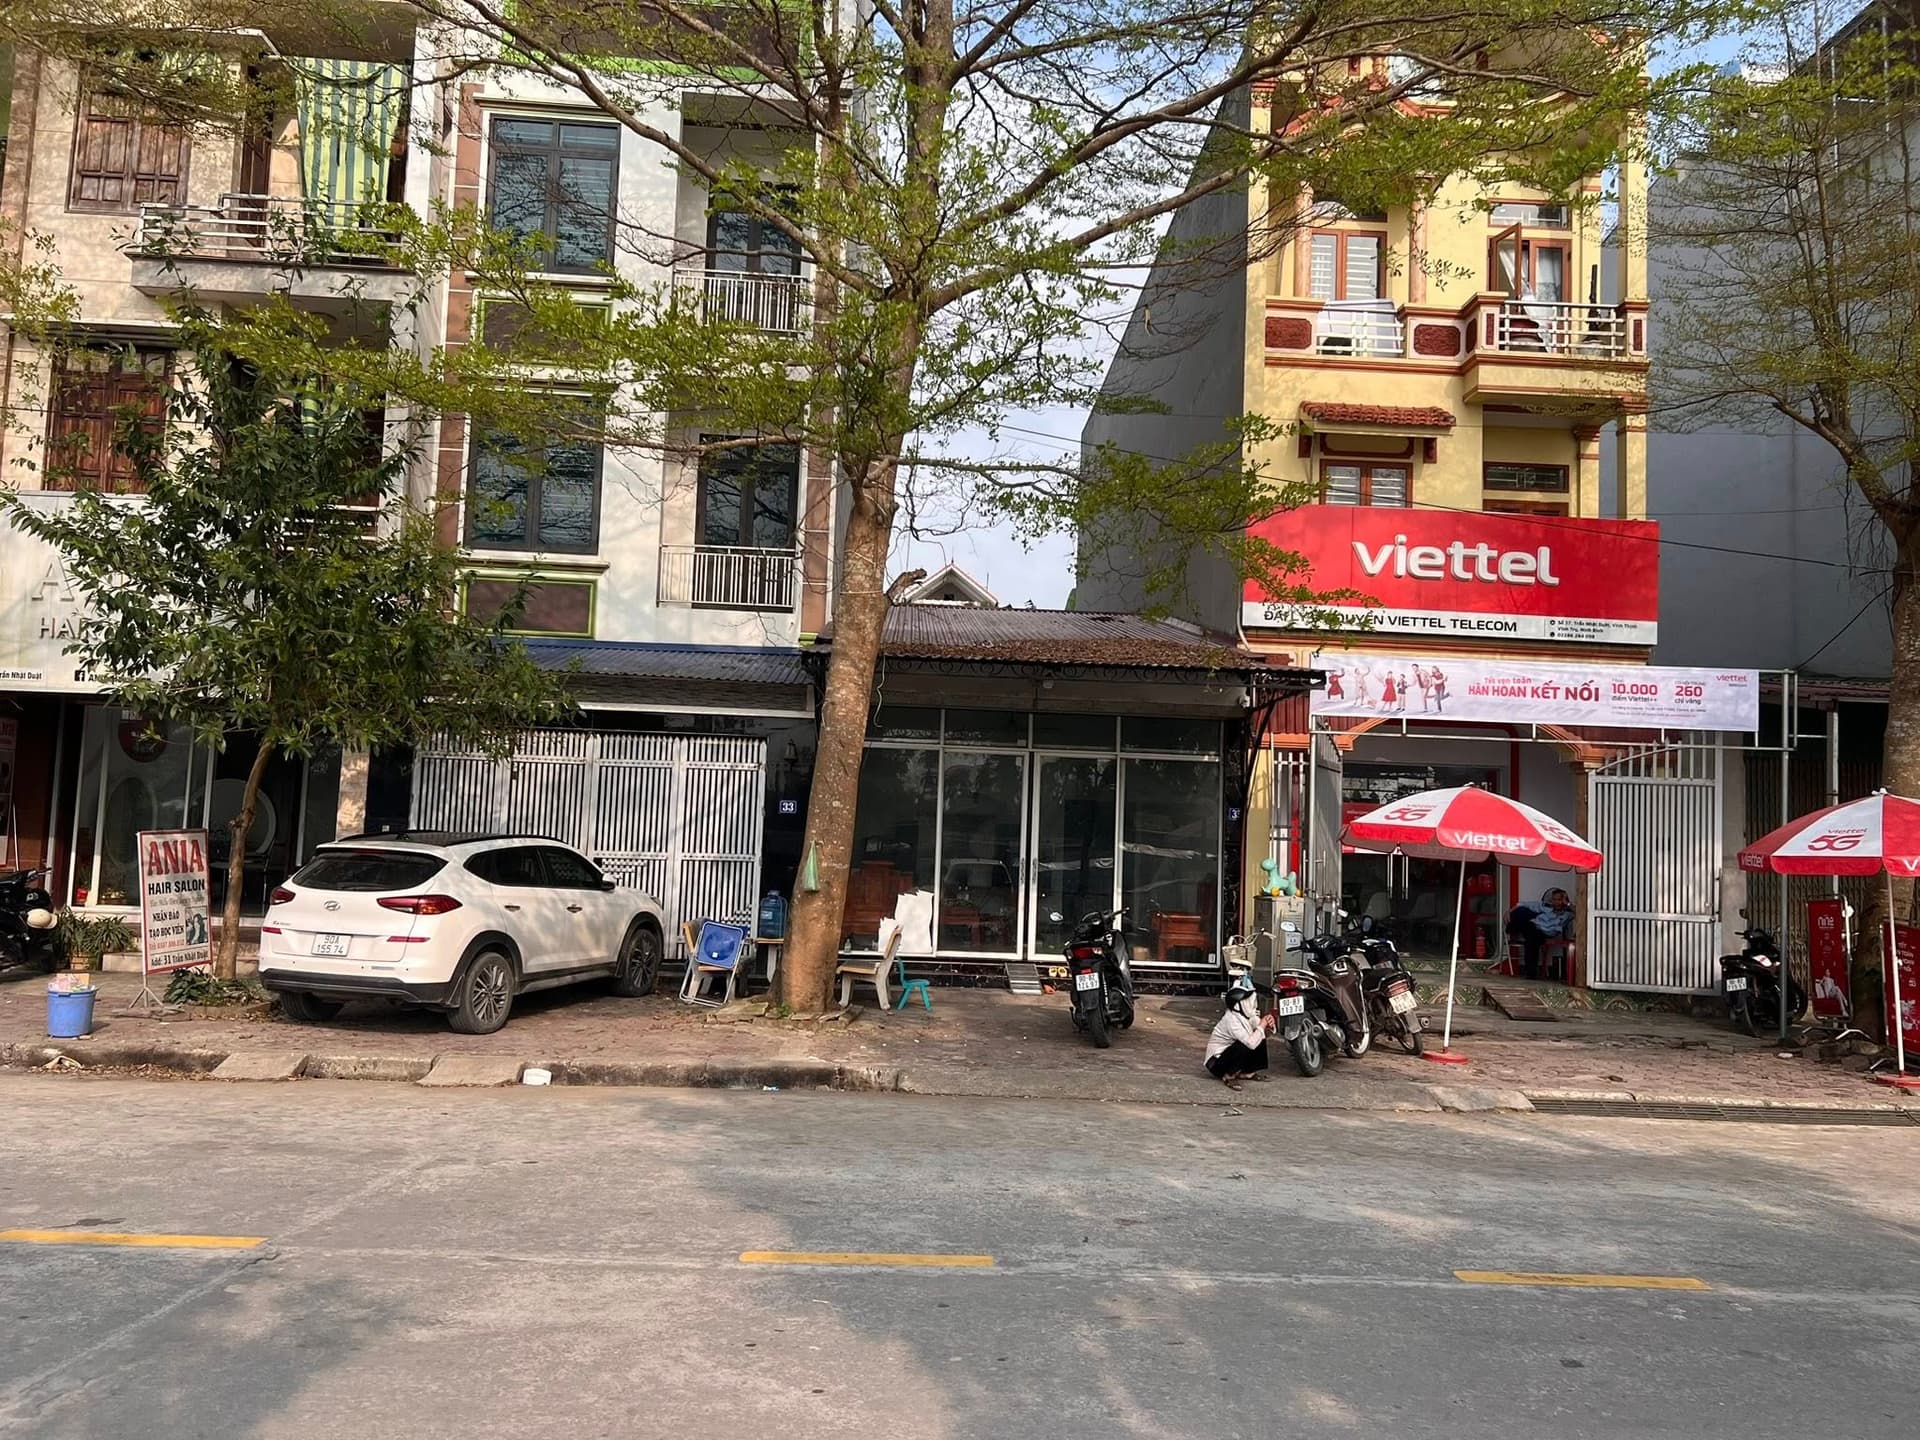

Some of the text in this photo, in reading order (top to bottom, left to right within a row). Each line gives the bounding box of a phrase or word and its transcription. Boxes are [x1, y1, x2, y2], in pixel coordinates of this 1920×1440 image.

[1351, 533, 1560, 586] viettel
[1388, 615, 1446, 629] VIETTEL
[1450, 618, 1518, 632] TELECOM
[1716, 674, 1747, 682] viettel
[1492, 685, 1526, 698] HOAN
[1531, 680, 1560, 700] KẾT
[1565, 680, 1600, 702] NỐI
[1611, 683, 1658, 695] 10.000
[1675, 685, 1703, 697] 260
[782, 802, 795, 812] 33
[1384, 808, 1432, 822] 5G
[1454, 830, 1529, 851] viettel
[1808, 834, 1866, 851] 5G
[148, 839, 205, 877] ANIA
[148, 878, 205, 896] HAIR SALON
[323, 935, 340, 945] 90A
[164, 955, 172, 964] 31
